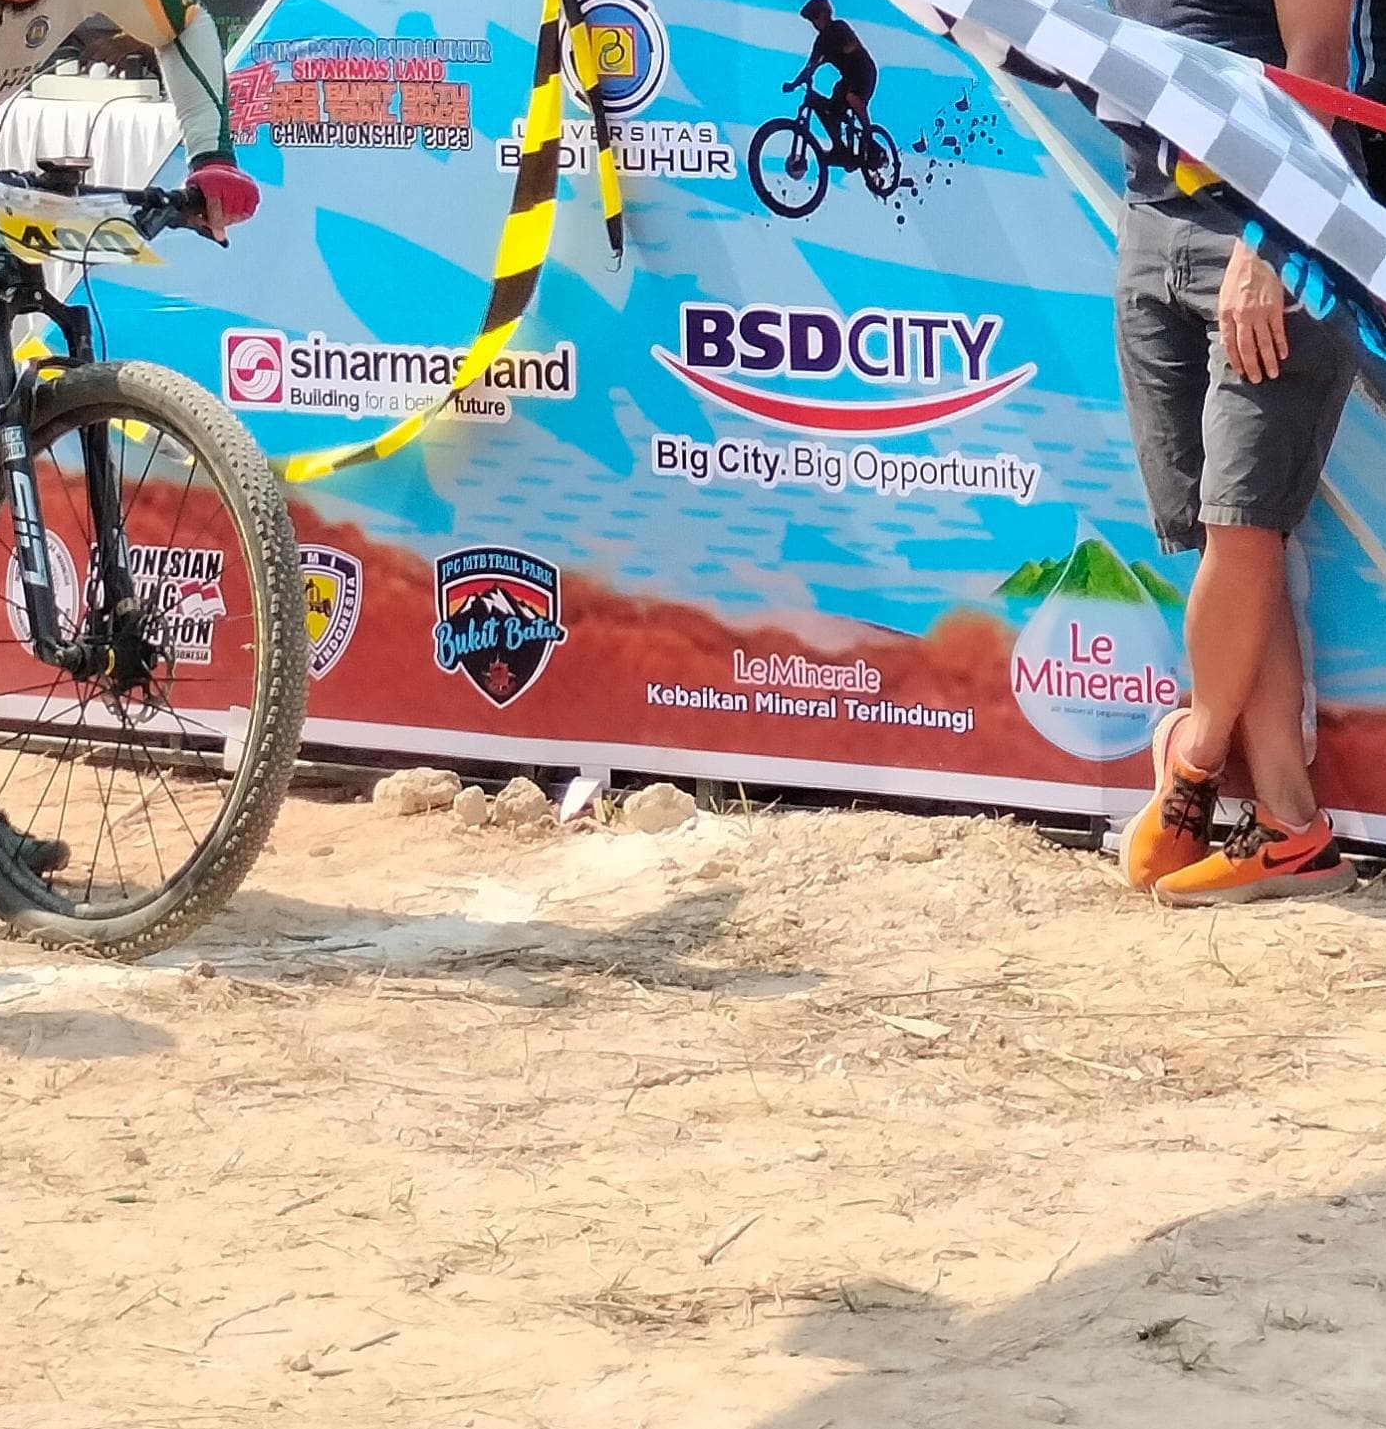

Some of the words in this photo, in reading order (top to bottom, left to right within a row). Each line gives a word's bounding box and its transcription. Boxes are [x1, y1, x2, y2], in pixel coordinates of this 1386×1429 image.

[292, 60, 390, 82] SINARMAS
[394, 60, 446, 82] LAND
[272, 123, 416, 149] CHAMPIONSHIP
[423, 126, 472, 150] 2023
[500, 144, 586, 169] BDI
[614, 147, 731, 173] UHUR
[684, 307, 997, 381] BSDCITY
[290, 387, 361, 411] Building
[363, 389, 385, 410] for
[389, 395, 400, 410] a
[454, 394, 506, 415] future
[656, 440, 709, 477] Big
[794, 446, 843, 487] Big
[853, 450, 1036, 499] Opportunity
[463, 553, 487, 571] MTB
[488, 553, 521, 572] TRAIL
[522, 560, 553, 587] PARK
[317, 575, 358, 666] INDONESIA
[436, 616, 501, 668] Bukit
[504, 616, 561, 651] Batu
[1070, 623, 1114, 666] Le
[734, 652, 766, 683] Le
[768, 654, 881, 694] Minerale
[1014, 657, 1177, 707] Minerale
[646, 683, 749, 712] Kebaikan
[755, 690, 837, 720] Mineral
[844, 695, 975, 732] Terlindungi
